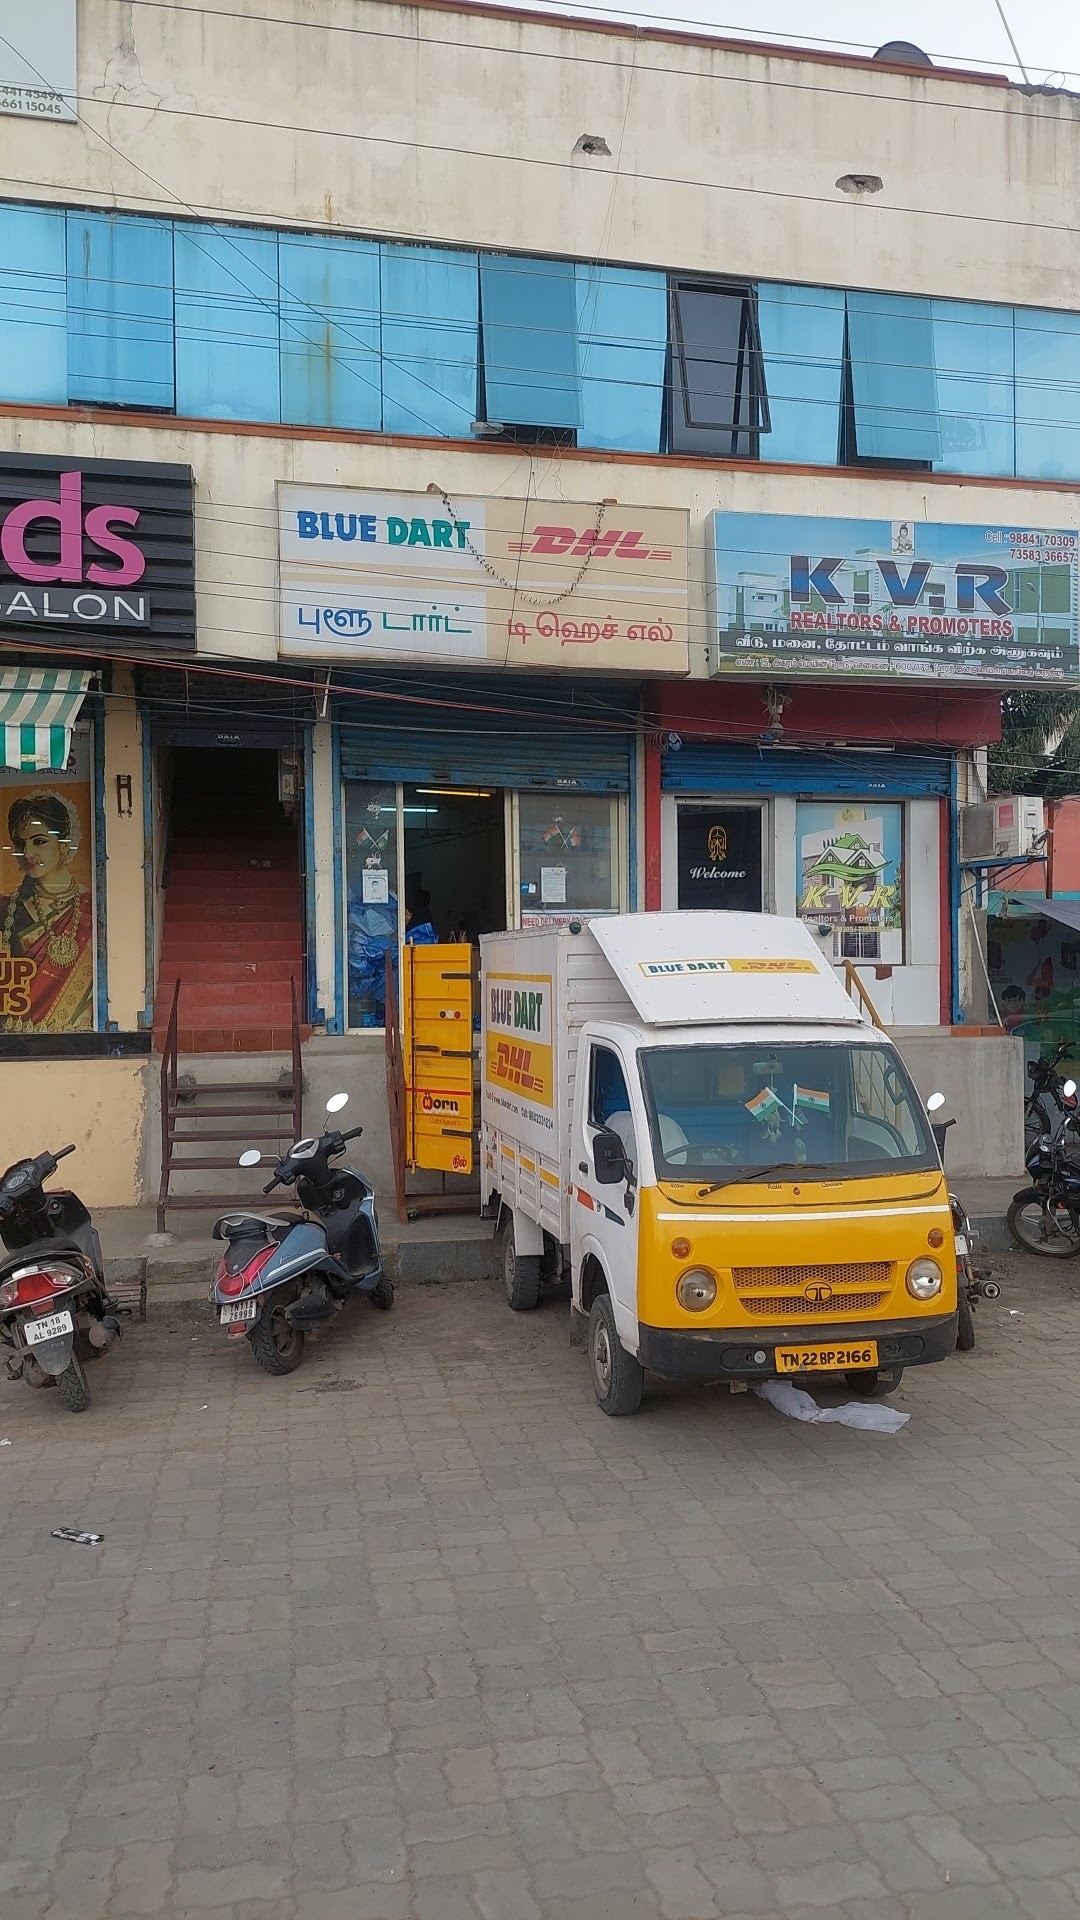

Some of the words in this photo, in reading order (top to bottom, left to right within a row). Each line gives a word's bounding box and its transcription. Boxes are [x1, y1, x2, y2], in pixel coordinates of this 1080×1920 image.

[26, 101, 61, 114] 15045
[1, 471, 146, 586] ds
[296, 511, 377, 543] BLUE
[387, 517, 471, 550] DART
[526, 526, 653, 560] DHL
[1010, 532, 1040, 544] 98841
[1044, 535, 1075, 547] 70309
[1009, 549, 1041, 560] 73583
[1044, 551, 1075, 562] 36657
[0, 591, 145, 621] ALON
[790, 611, 882, 632] REALTORS
[888, 615, 902, 632] &
[907, 616, 1014, 638] PROMOTERS
[689, 866, 747, 880] Welcome
[522, 917, 539, 927] NEED
[802, 914, 838, 923] Realtors
[849, 914, 894, 923] Promoters
[648, 964, 684, 974] BLUE
[687, 961, 726, 972] DART
[491, 988, 512, 1026] BLUE
[514, 990, 543, 1033] DART
[494, 1042, 538, 1089] DHL
[422, 1094, 458, 1112] Horn
[34, 1332, 45, 1341] AL
[47, 1323, 67, 1336] 9289
[36, 1320, 48, 1330] TN
[51, 1316, 60, 1325] 18
